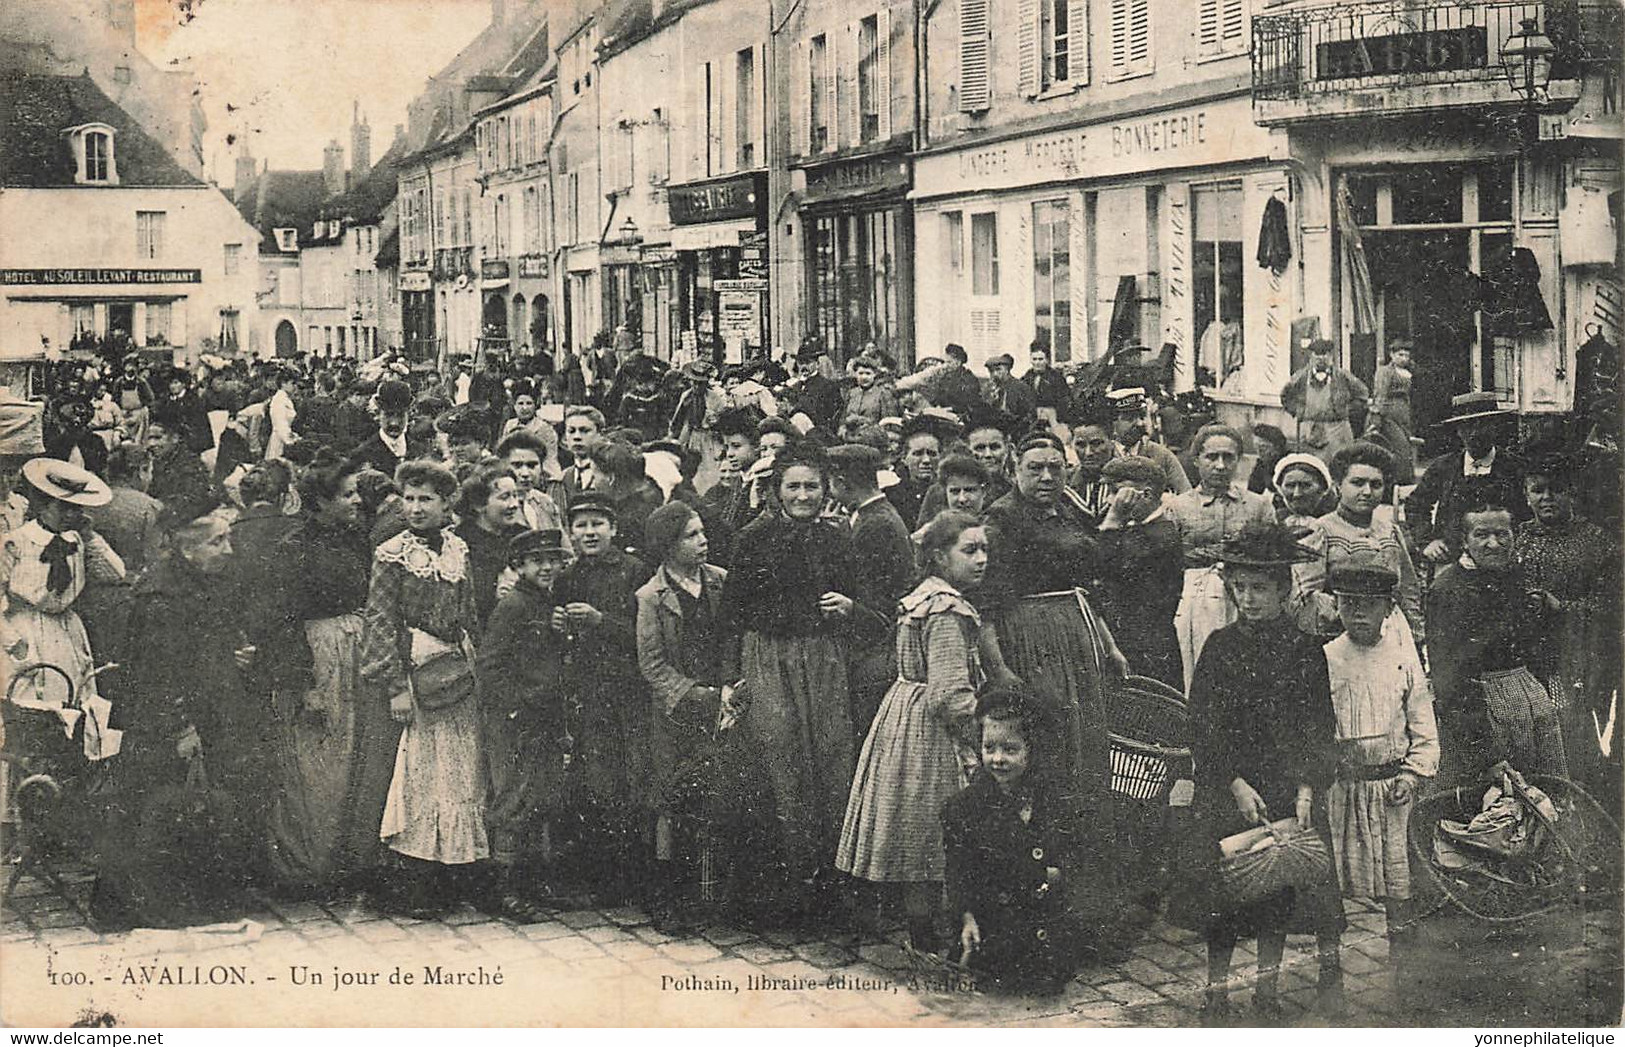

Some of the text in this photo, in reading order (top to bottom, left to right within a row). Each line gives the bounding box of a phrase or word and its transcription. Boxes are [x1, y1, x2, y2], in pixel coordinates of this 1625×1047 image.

[1112, 113, 1205, 157] BONNETERIE
[43, 270, 56, 282] AU
[57, 269, 95, 282] SOLEIL
[97, 269, 131, 282] LEVANT
[137, 270, 194, 282] RESTAURANT
